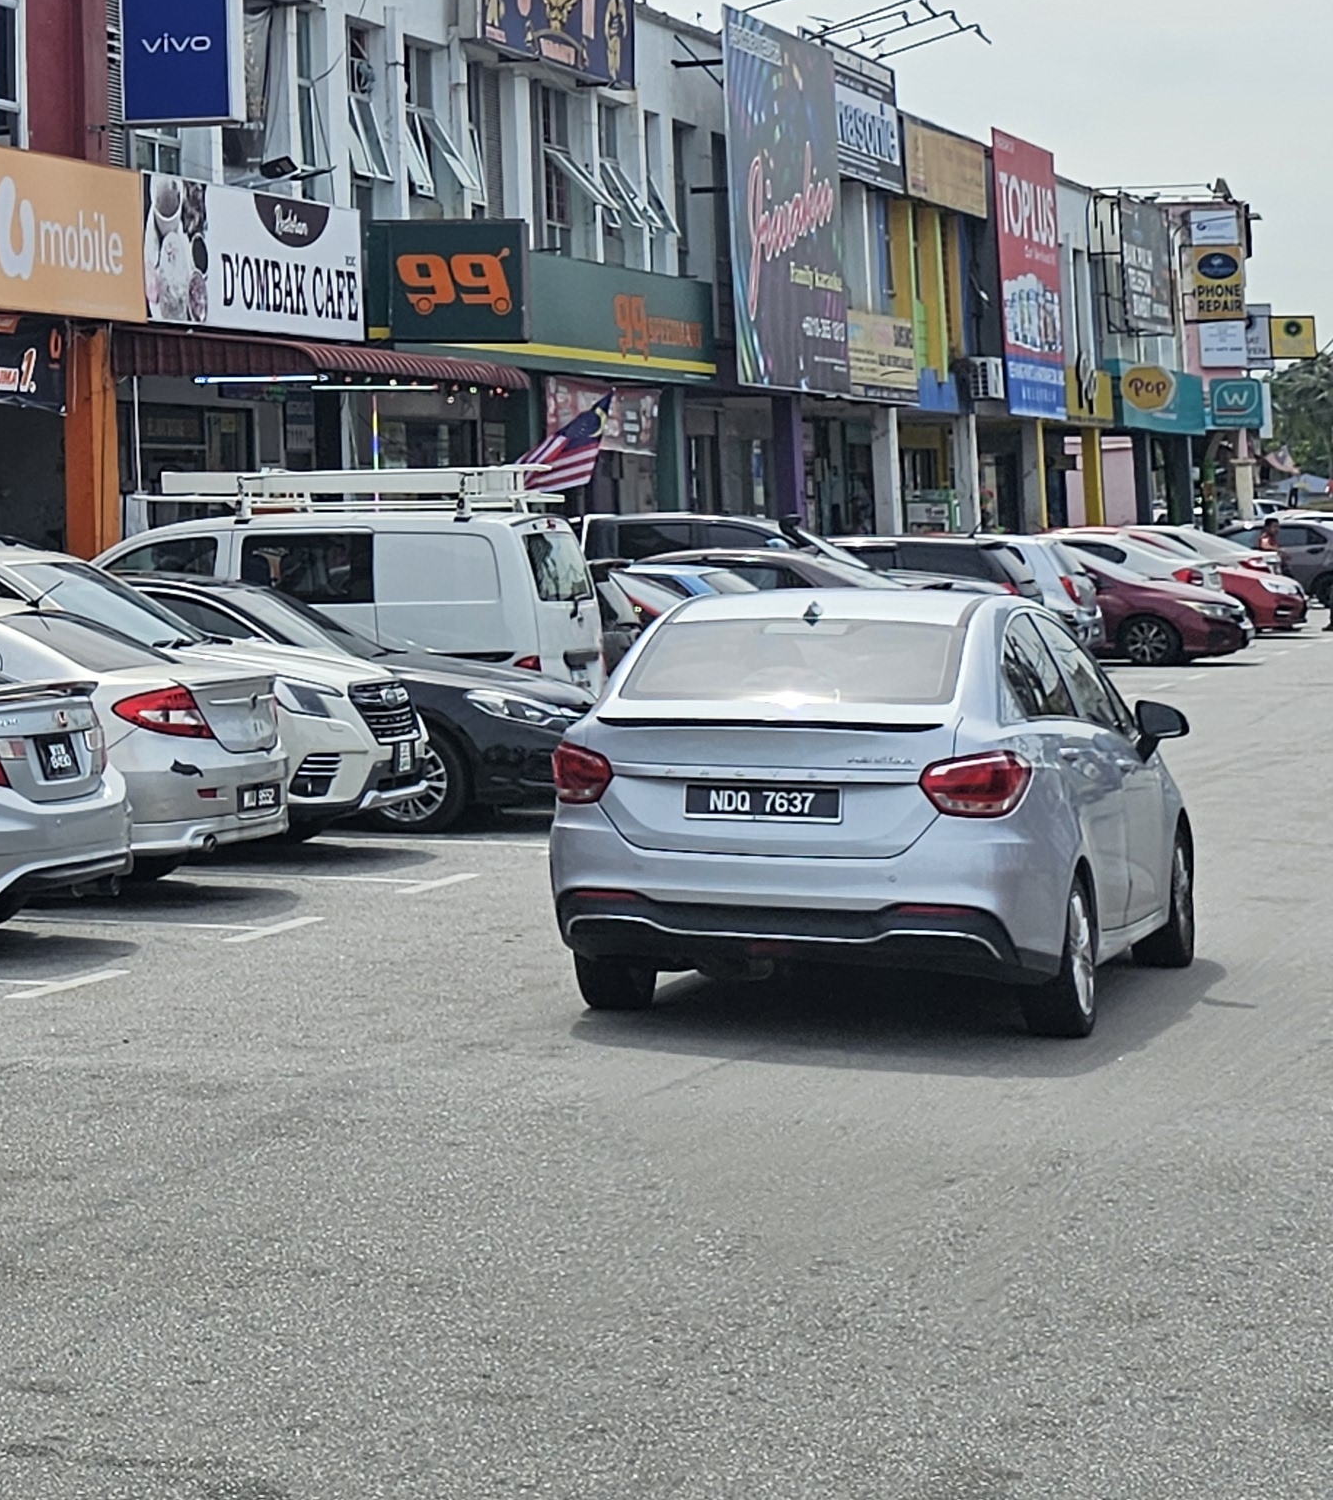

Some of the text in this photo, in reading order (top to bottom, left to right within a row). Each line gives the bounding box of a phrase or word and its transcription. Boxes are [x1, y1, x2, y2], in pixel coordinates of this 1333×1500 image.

[141, 32, 212, 54] vivo
[997, 172, 1056, 249] TOPLUS
[39, 210, 124, 276] mobile
[221, 253, 308, 316] D'OMBAK
[396, 247, 513, 316] 99
[1197, 299, 1244, 313] REPAIR
[708, 791, 817, 815] NDQ 7637
